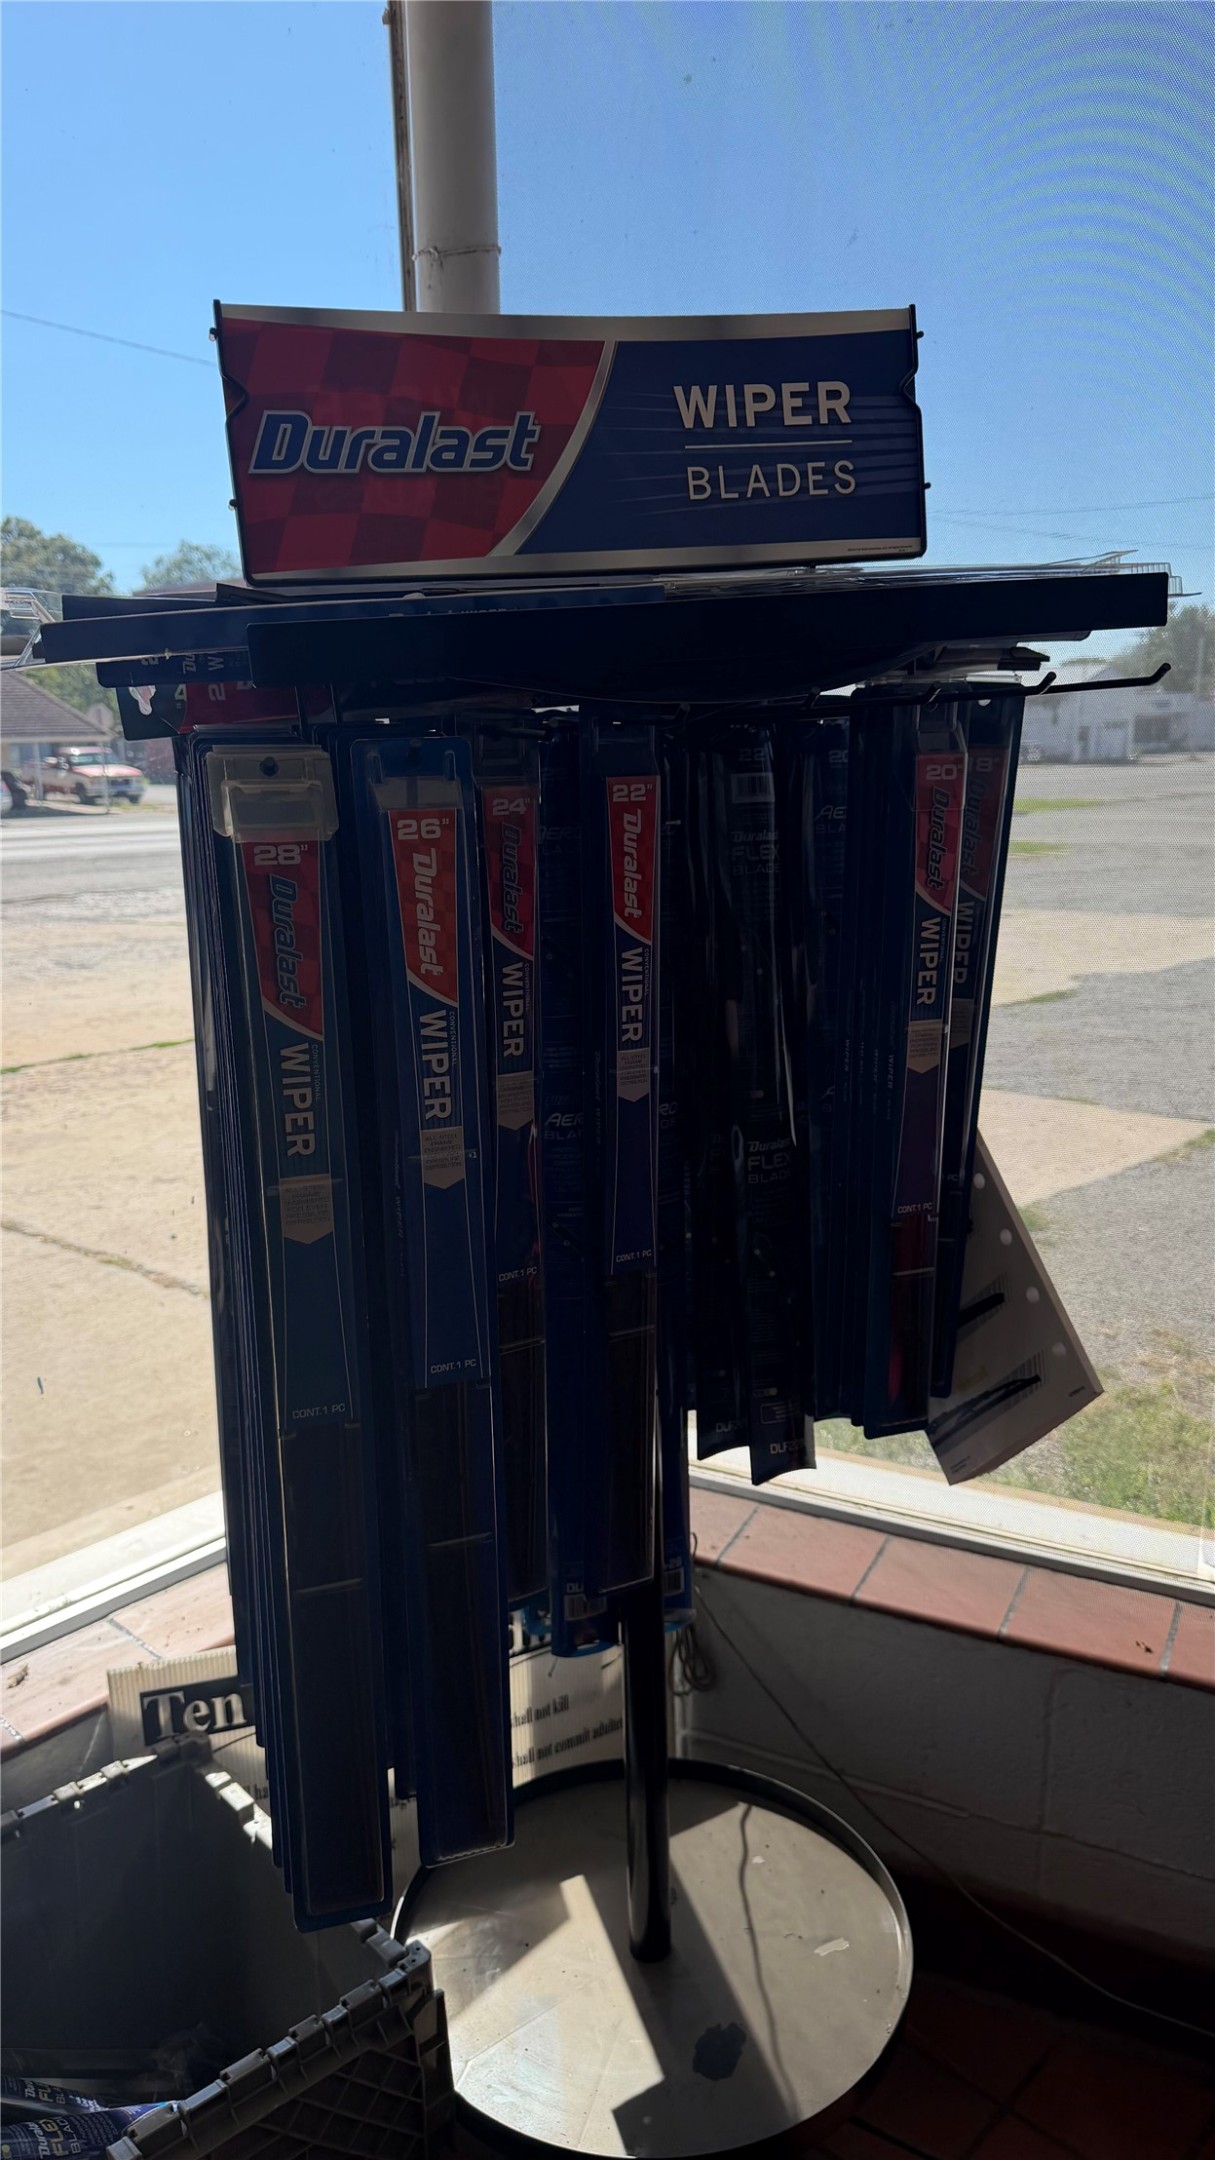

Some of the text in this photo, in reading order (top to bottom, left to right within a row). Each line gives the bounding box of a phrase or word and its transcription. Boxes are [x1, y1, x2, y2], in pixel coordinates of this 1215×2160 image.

[673, 381, 852, 429] WIPER
[248, 410, 541, 474] Duralast
[687, 460, 856, 500] BLADES
[492, 797, 530, 816] 24"
[612, 783, 653, 803] 22"
[396, 818, 449, 841] 26"
[926, 785, 951, 891] Duralast
[253, 844, 308, 866] 28"
[502, 822, 524, 935] Duralast
[623, 808, 643, 919] Duralast
[412, 847, 444, 976] Duralast
[269, 873, 306, 1009] Duralast
[916, 917, 942, 1006] WIPER
[502, 961, 525, 1058] WIPER
[621, 947, 643, 1042] WIPER
[312, 1043, 322, 1102] CONVENTIONAL
[419, 1009, 452, 1121] WIPER
[280, 1042, 316, 1157] WIPER
[544, 1129, 582, 1140] BLA
[526, 1266, 537, 1275] PC
[642, 1249, 653, 1257] PC
[464, 1358, 477, 1368] PC
[331, 1402, 346, 1413] PC
[143, 1690, 247, 1739] Ten
[534, 1704, 551, 1721] not
[552, 1694, 569, 1713] kill
[555, 1728, 591, 1753] commit
